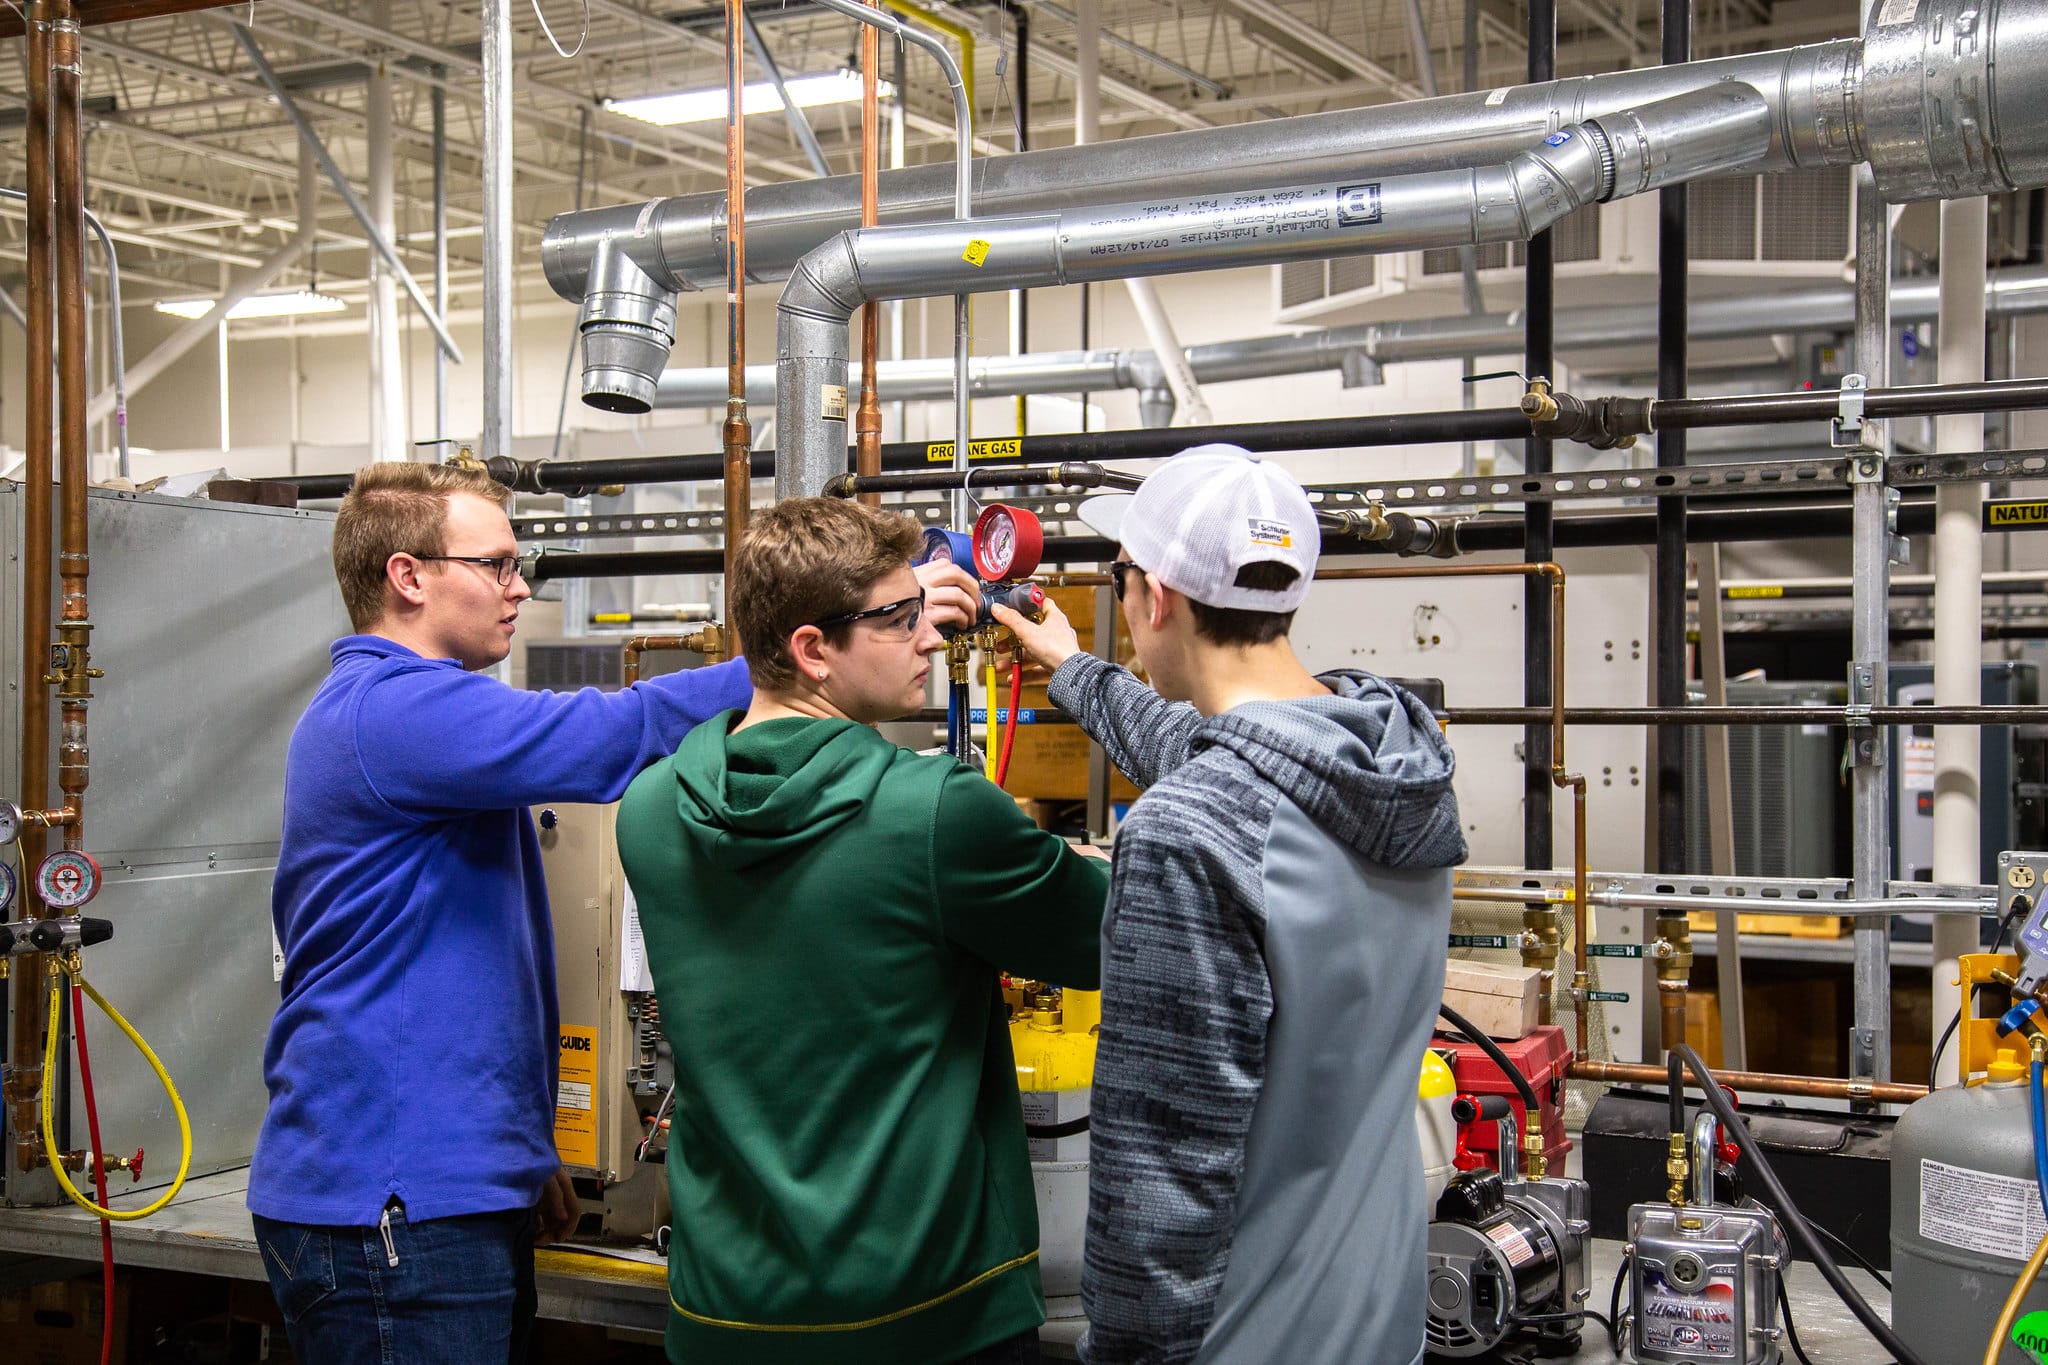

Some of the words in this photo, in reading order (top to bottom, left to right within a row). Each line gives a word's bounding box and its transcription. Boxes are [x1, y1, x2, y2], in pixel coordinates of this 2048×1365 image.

[1142, 203, 1180, 217] Pend.
[1265, 218, 1331, 237] Ductmate
[1179, 226, 1258, 246] Industries
[931, 443, 988, 458] PRONE
[991, 441, 1016, 454] GAS
[1250, 529, 1282, 542] Systems
[971, 710, 1010, 722] PRESE
[560, 1035, 591, 1052] GUIDE
[1922, 1161, 1945, 1173] DANGER
[1680, 1297, 1704, 1306] VACUUM
